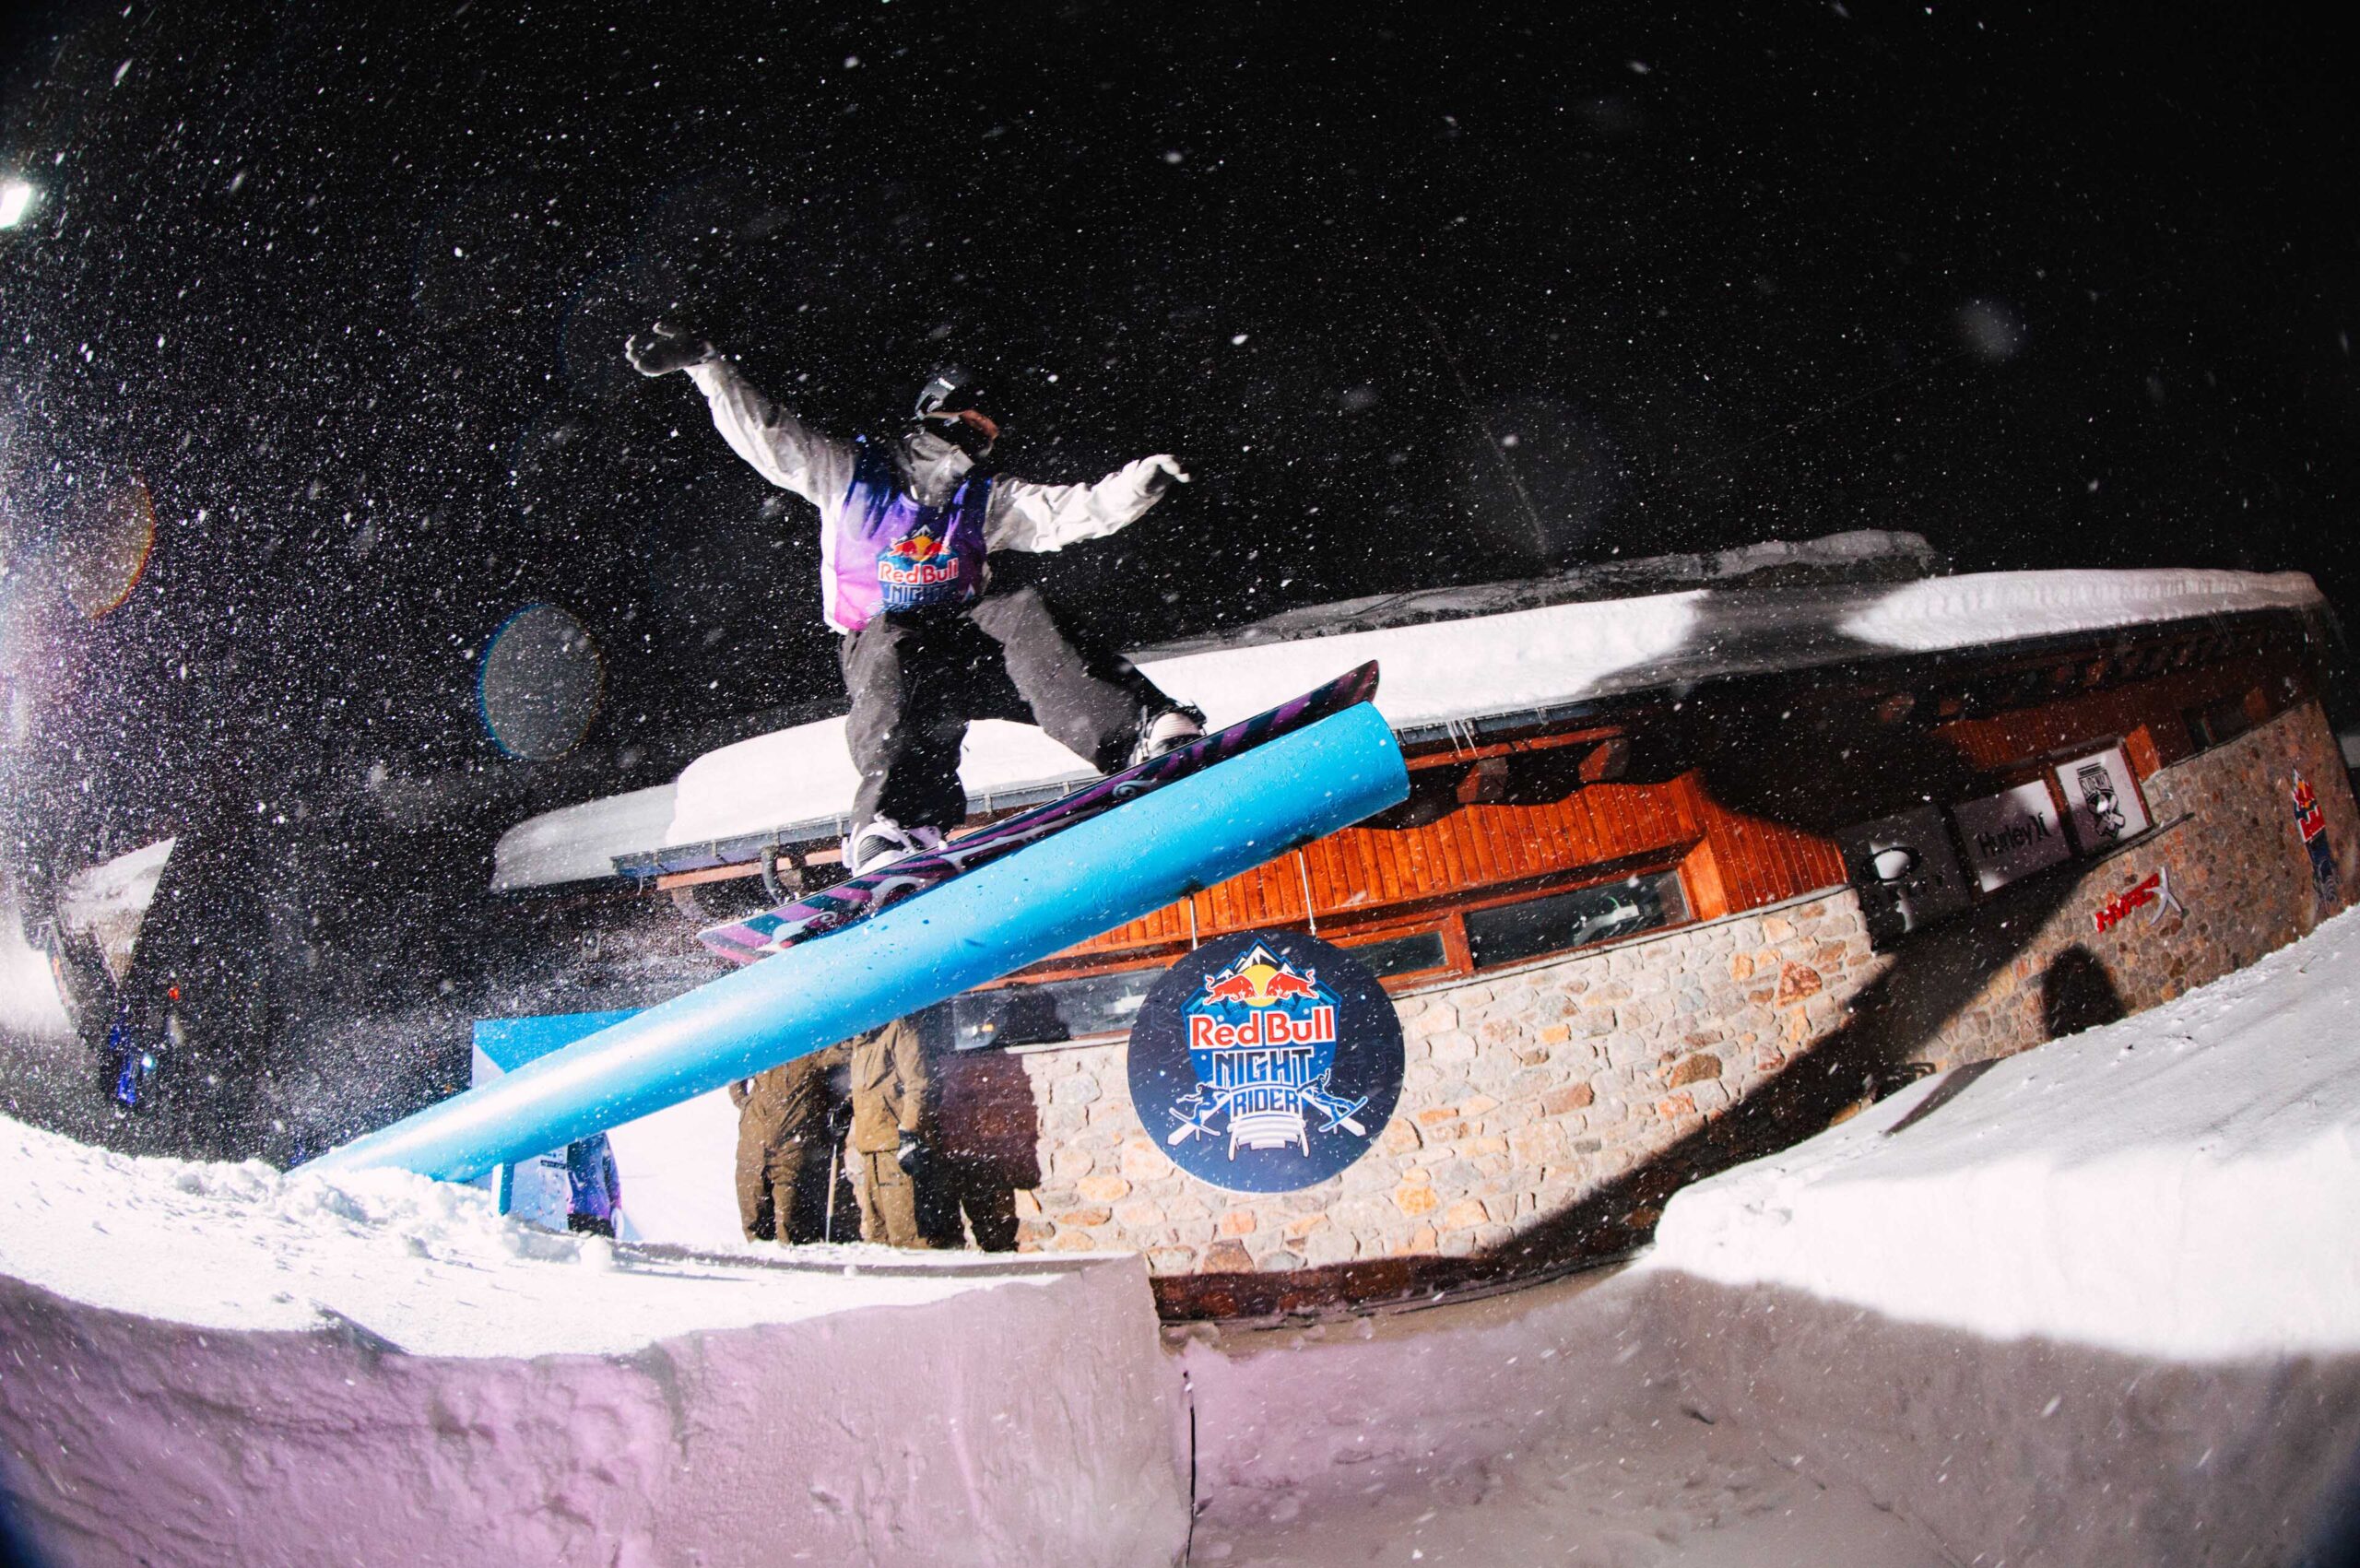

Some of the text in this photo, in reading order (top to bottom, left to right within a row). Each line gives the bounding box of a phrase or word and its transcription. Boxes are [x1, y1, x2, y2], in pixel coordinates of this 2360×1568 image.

[879, 558, 958, 584] Red Bull
[1976, 822, 2033, 858] Hurley
[1191, 1007, 1334, 1048] Red Bull
[1213, 1047, 1314, 1089] NIGHT
[1232, 1088, 1301, 1118] RIDER
